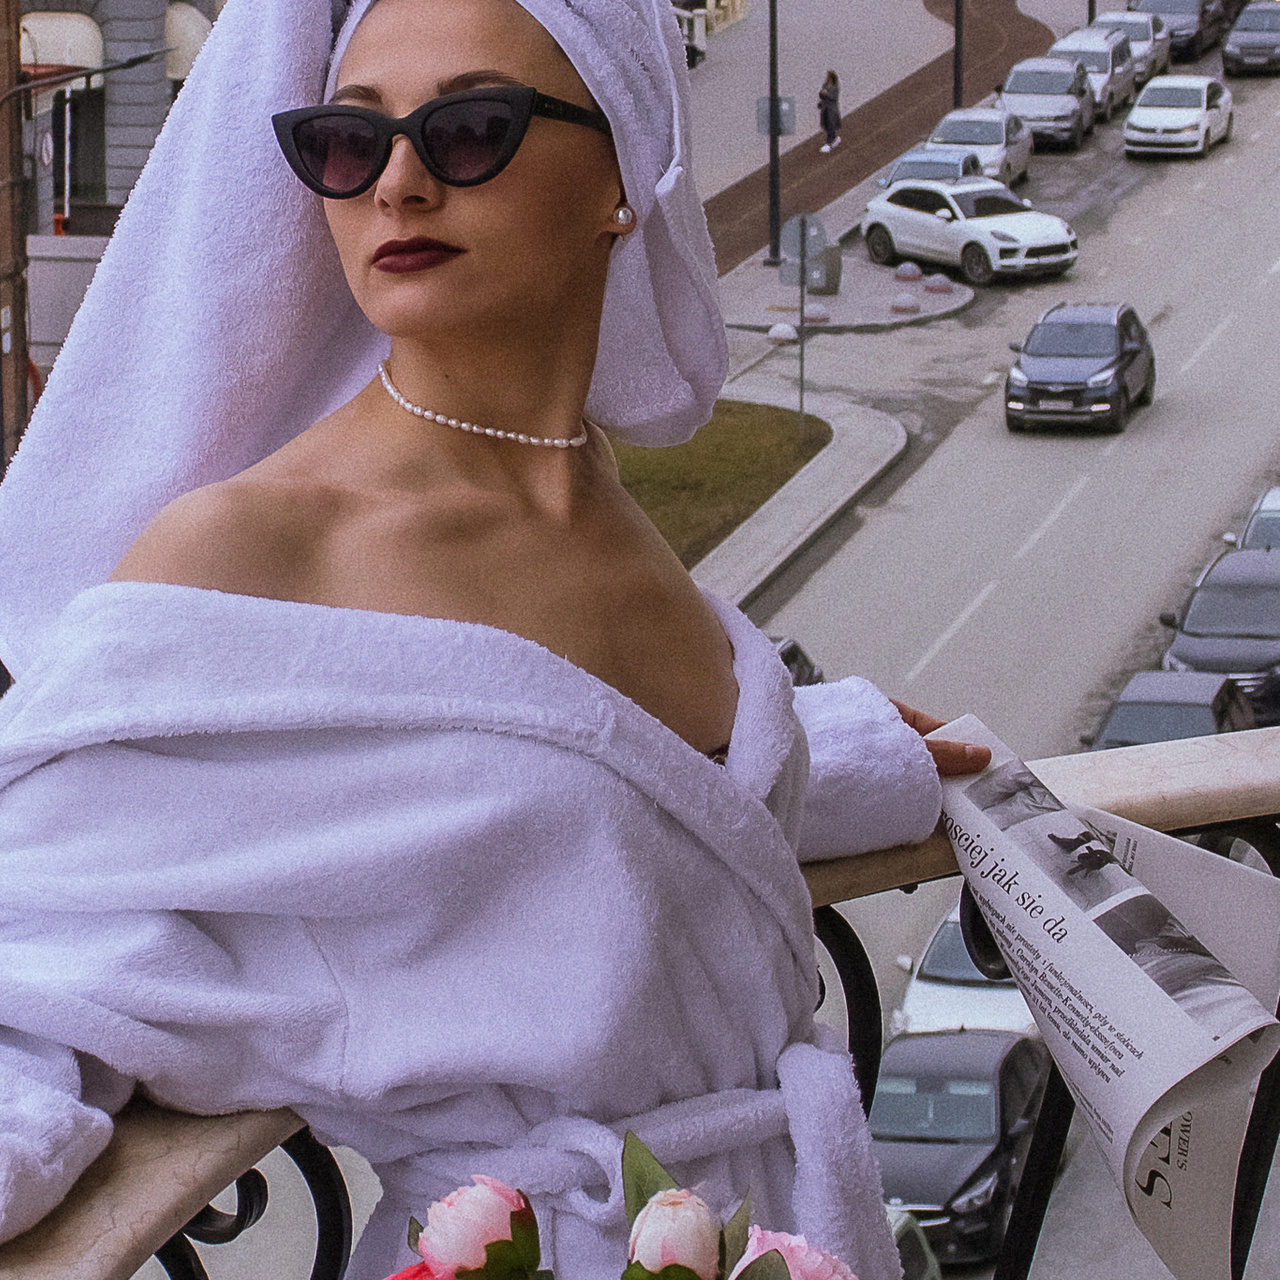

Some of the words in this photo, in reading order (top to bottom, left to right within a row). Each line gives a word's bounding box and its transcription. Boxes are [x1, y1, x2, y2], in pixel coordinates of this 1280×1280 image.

[980, 858, 1020, 895] jak
[1014, 891, 1045, 919] sie
[1042, 915, 1068, 944] da
[1092, 1012, 1110, 1027] gdy
[1109, 1063, 1125, 1078] nad
